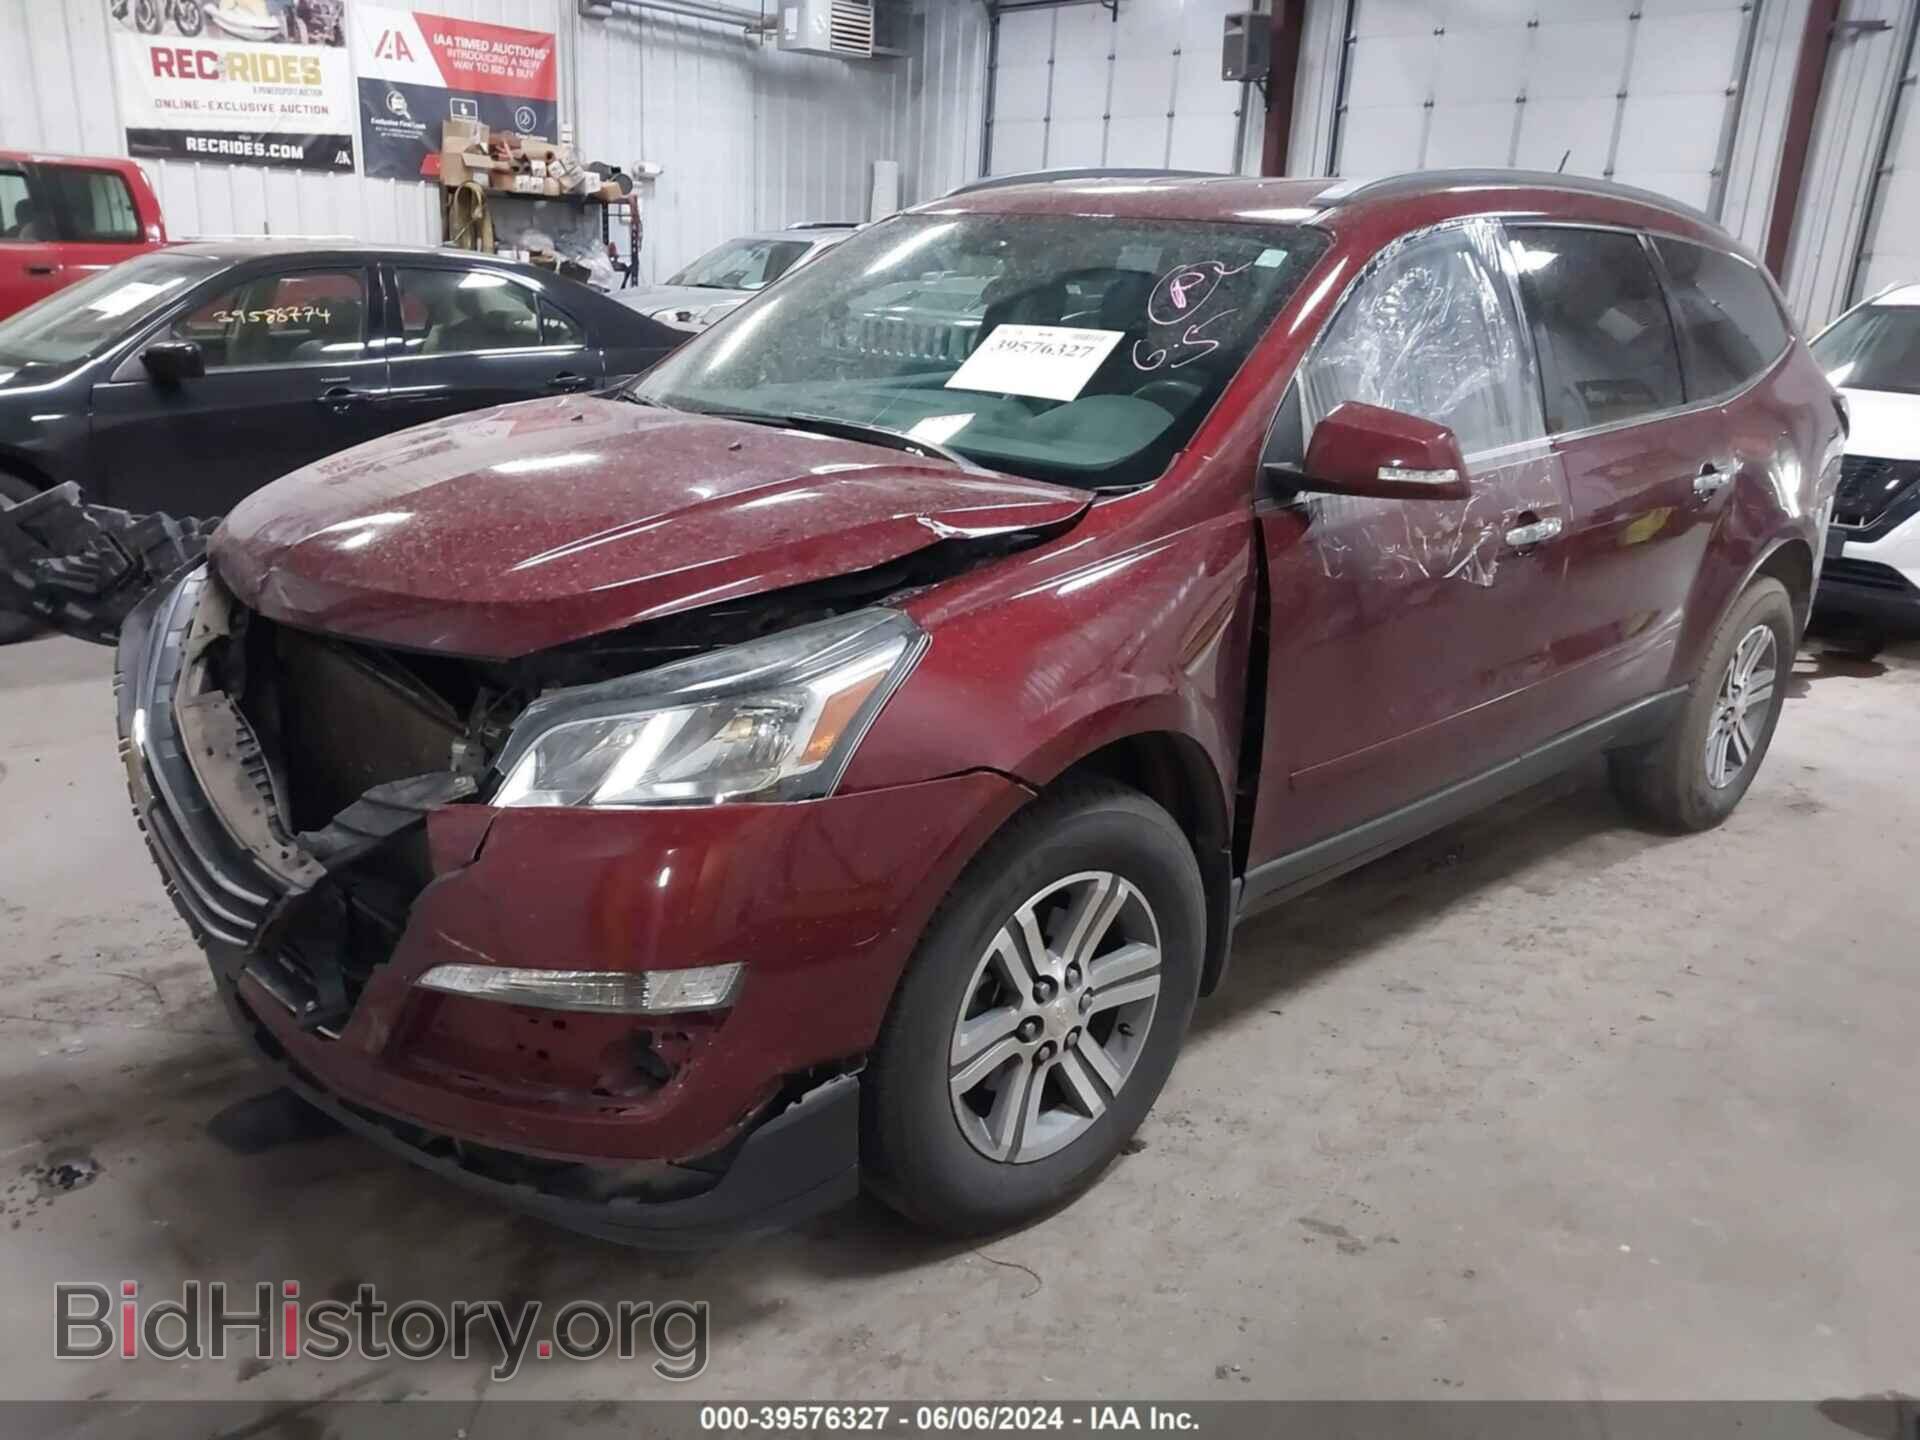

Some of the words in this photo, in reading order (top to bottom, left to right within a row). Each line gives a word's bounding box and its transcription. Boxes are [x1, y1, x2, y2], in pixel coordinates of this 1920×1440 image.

[454, 36, 489, 51] TIMED
[453, 60, 474, 71] WAY
[476, 62, 489, 71] TO
[516, 67, 535, 79] BUY
[155, 98, 275, 113] ONLINE-EXCLUSIVE
[280, 103, 329, 115] AUCTION
[186, 137, 304, 160] RECRIDES.COM
[213, 306, 331, 324] 39588774
[990, 339, 1096, 358] 39576327
